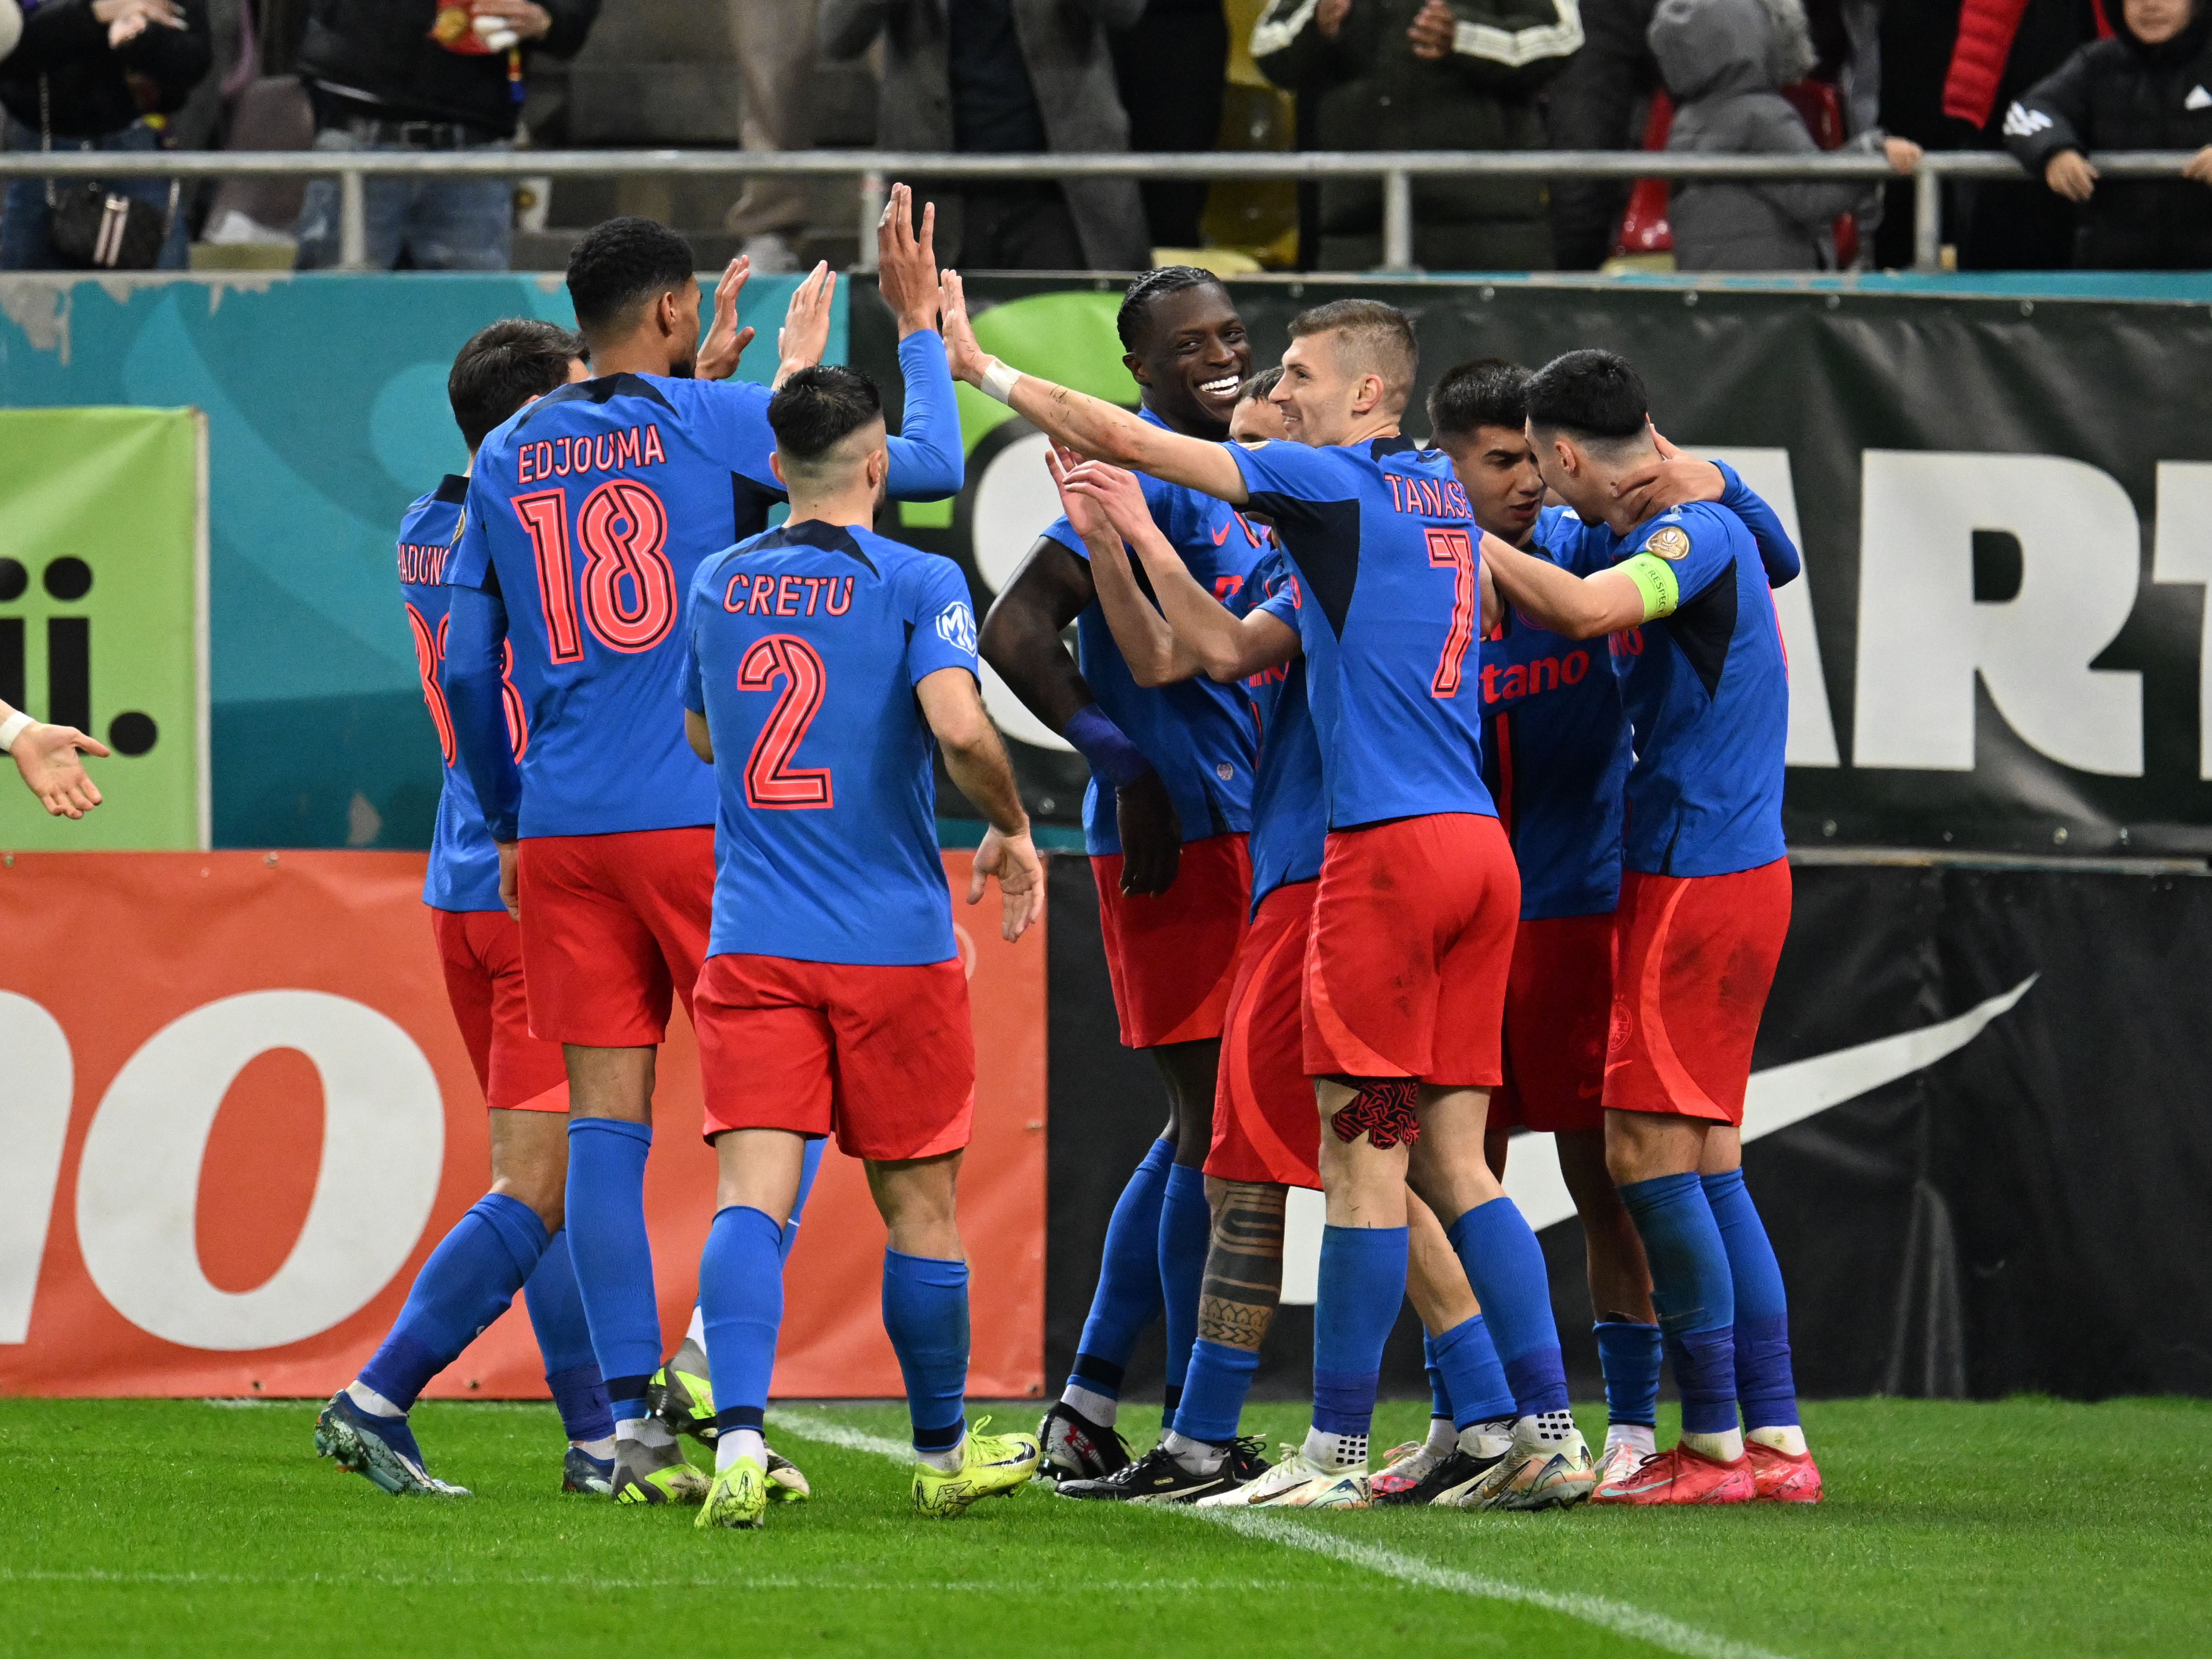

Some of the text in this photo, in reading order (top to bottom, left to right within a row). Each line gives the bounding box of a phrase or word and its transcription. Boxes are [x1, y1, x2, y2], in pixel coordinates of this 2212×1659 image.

[517, 424, 666, 484] EDJOUMA
[511, 479, 678, 665] 18
[723, 574, 853, 616] CRETU
[1424, 528, 1475, 698] 7
[737, 634, 834, 809] 2
[1478, 650, 1590, 704] tano
